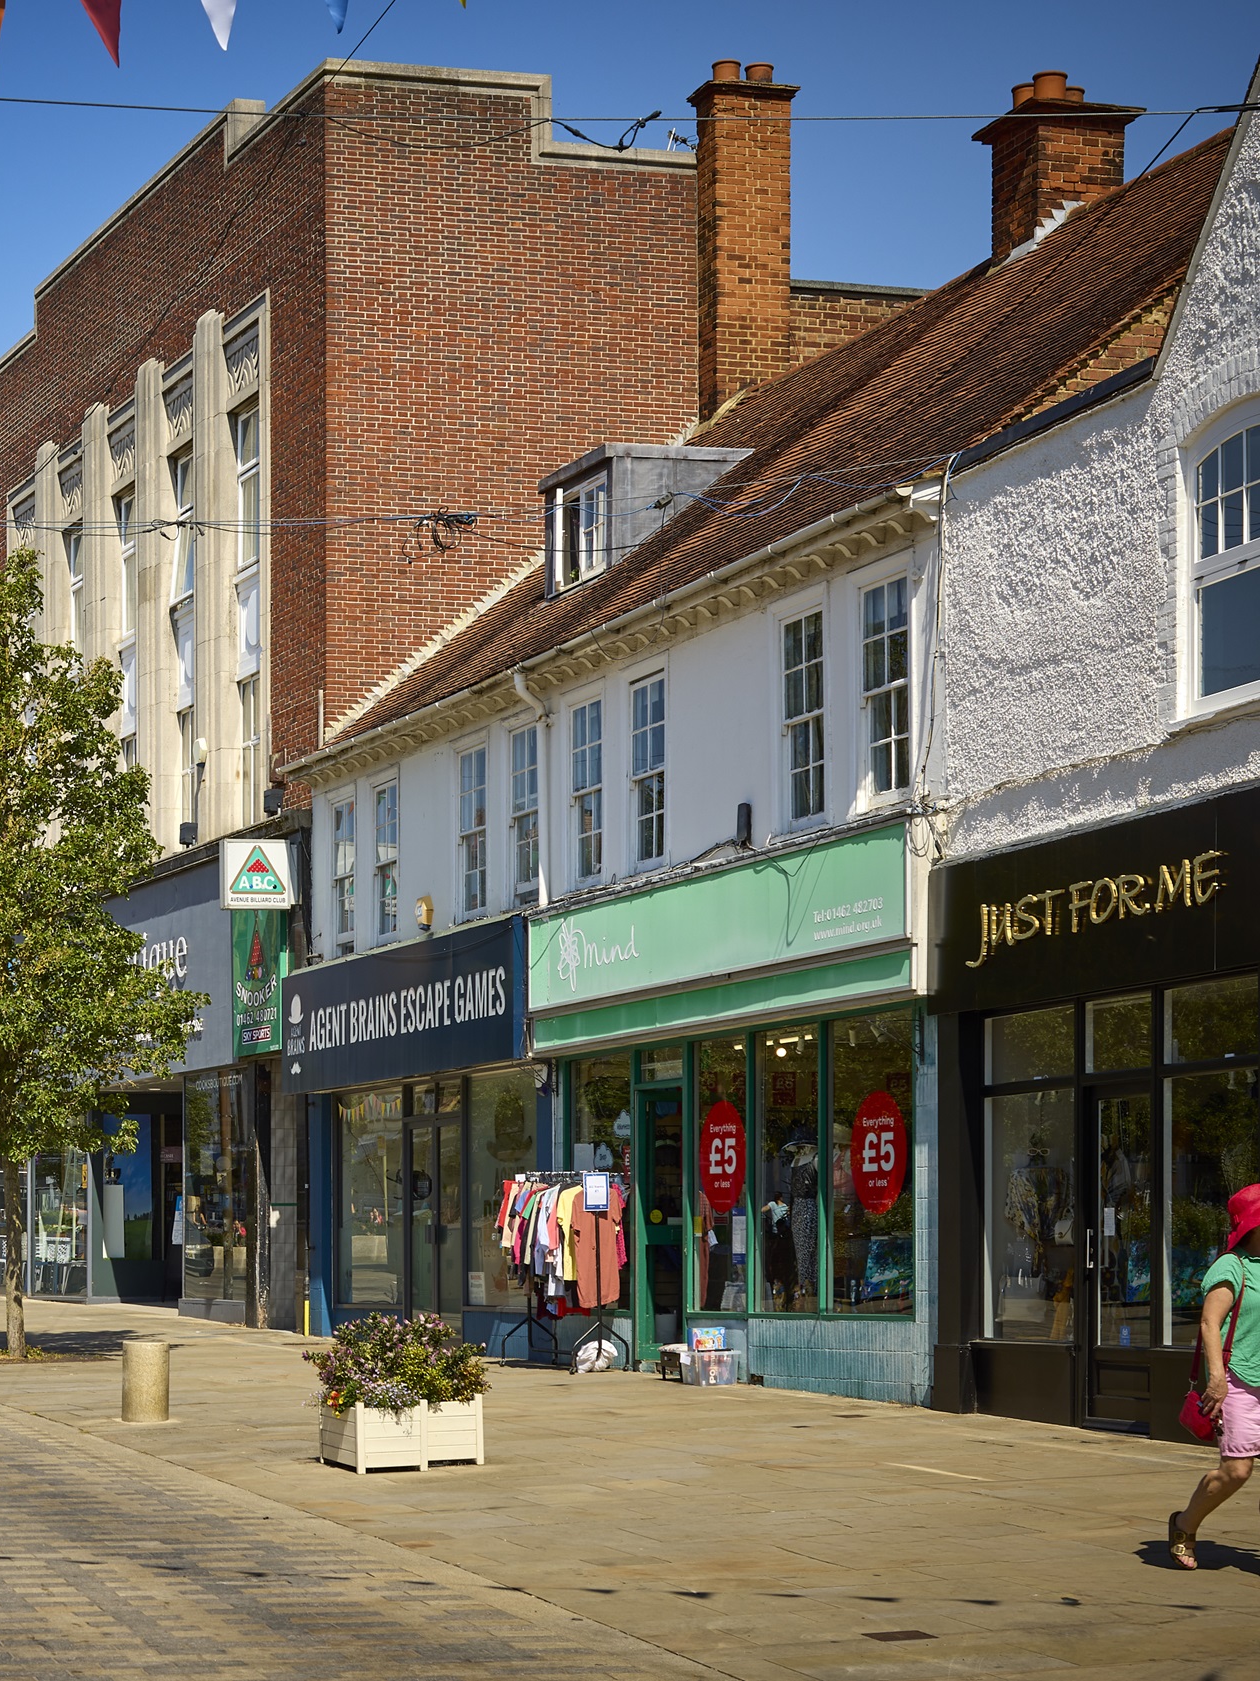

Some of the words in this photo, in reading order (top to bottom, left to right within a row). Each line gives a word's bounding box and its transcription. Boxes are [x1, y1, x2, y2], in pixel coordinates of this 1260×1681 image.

[250, 896, 272, 904] BILLIARD
[852, 896, 884, 914] 482703
[965, 889, 1066, 968] JUST
[1068, 874, 1150, 933] FOR
[1156, 850, 1221, 913] ME
[813, 915, 883, 941] www.mind.org.uk
[235, 973, 278, 1007] SNOOKER
[236, 1011, 254, 1027] 01462
[256, 1007, 277, 1022] 480721
[309, 1002, 347, 1051] AGENT
[349, 991, 397, 1044] BRAINS
[400, 979, 451, 1035] ESCAPE
[454, 965, 506, 1024] GAMES
[243, 1030, 253, 1042] SKY
[252, 1027, 271, 1040] SPORTS
[709, 1124, 737, 1135] Everything
[862, 1116, 895, 1129] Everything
[709, 1137, 737, 1175] £5
[862, 1131, 895, 1172] £5
[868, 1179, 875, 1187] or
